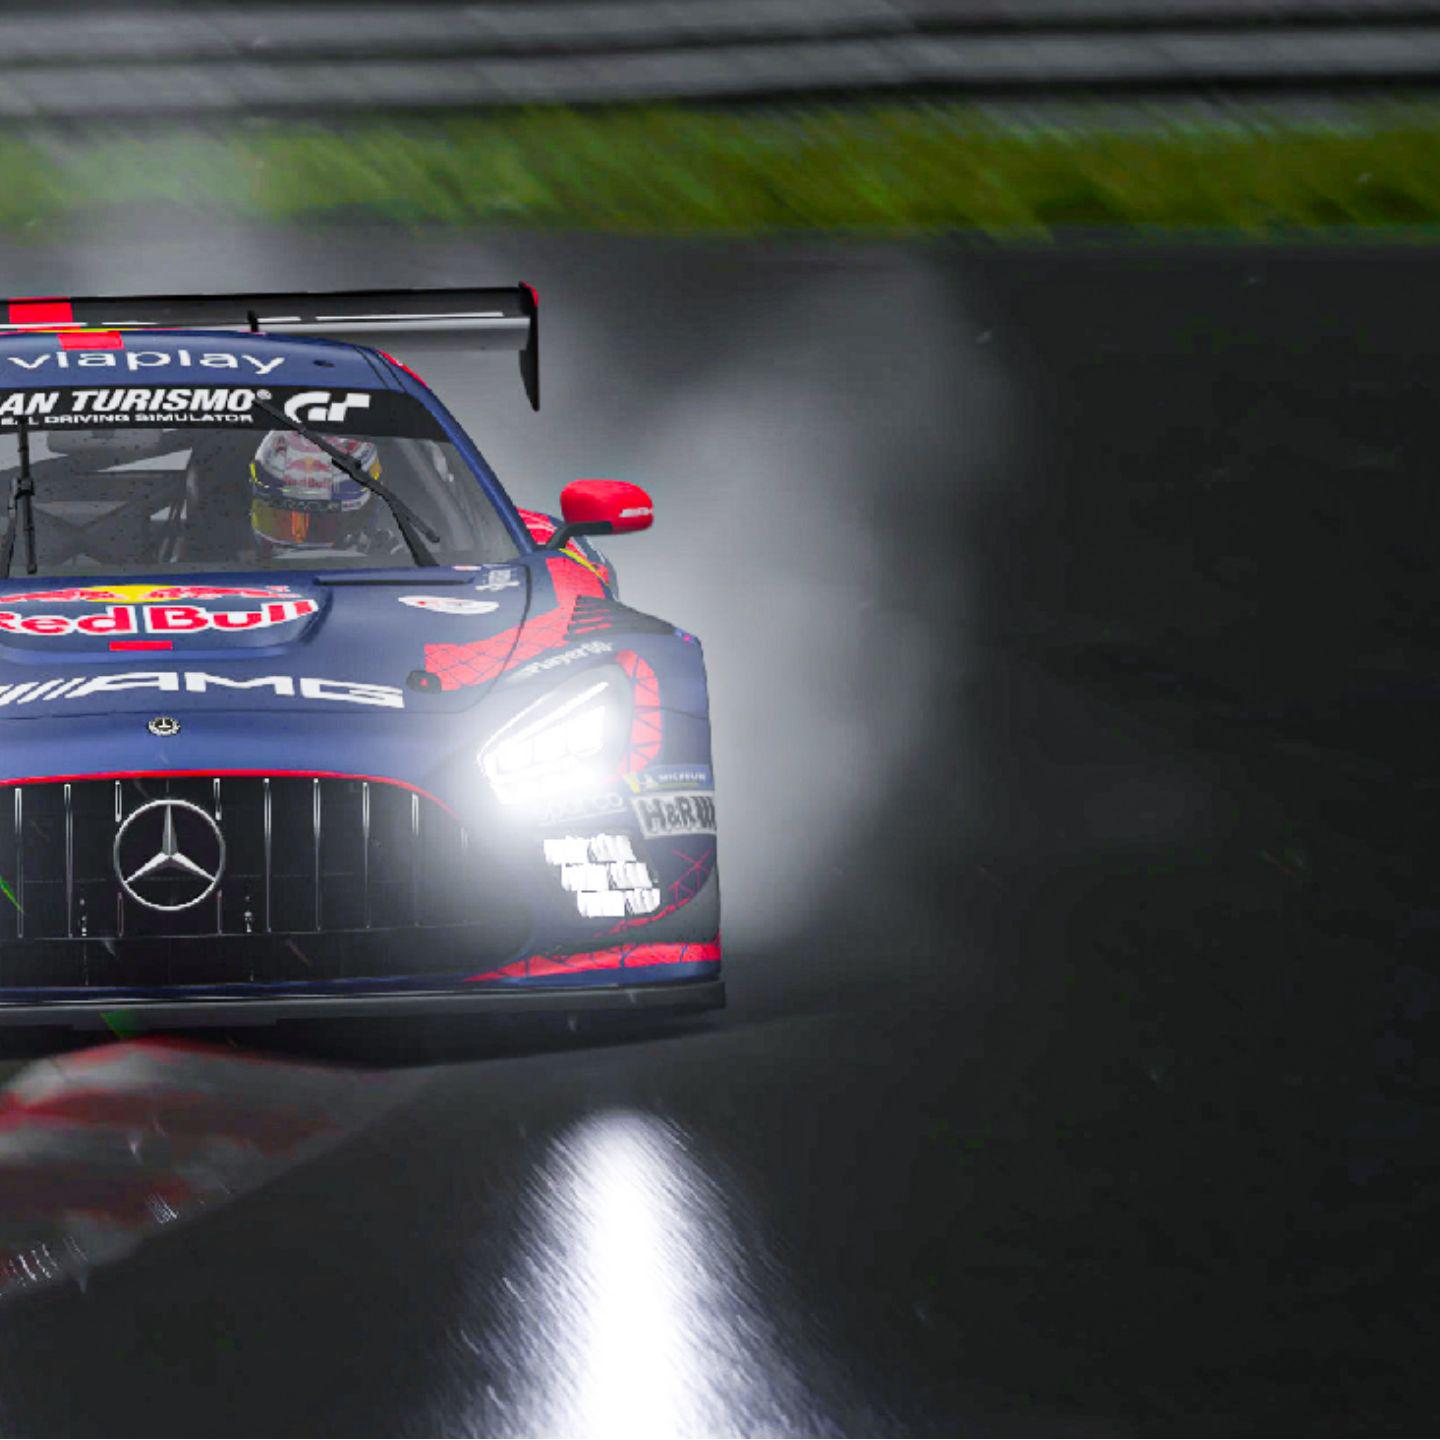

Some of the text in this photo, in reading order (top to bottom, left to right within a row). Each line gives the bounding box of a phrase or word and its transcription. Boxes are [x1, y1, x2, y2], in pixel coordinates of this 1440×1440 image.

[7, 350, 286, 375] viaplay
[45, 415, 130, 424] DRIVING
[135, 414, 254, 423] SIMULATOR
[144, 599, 319, 633] Bull
